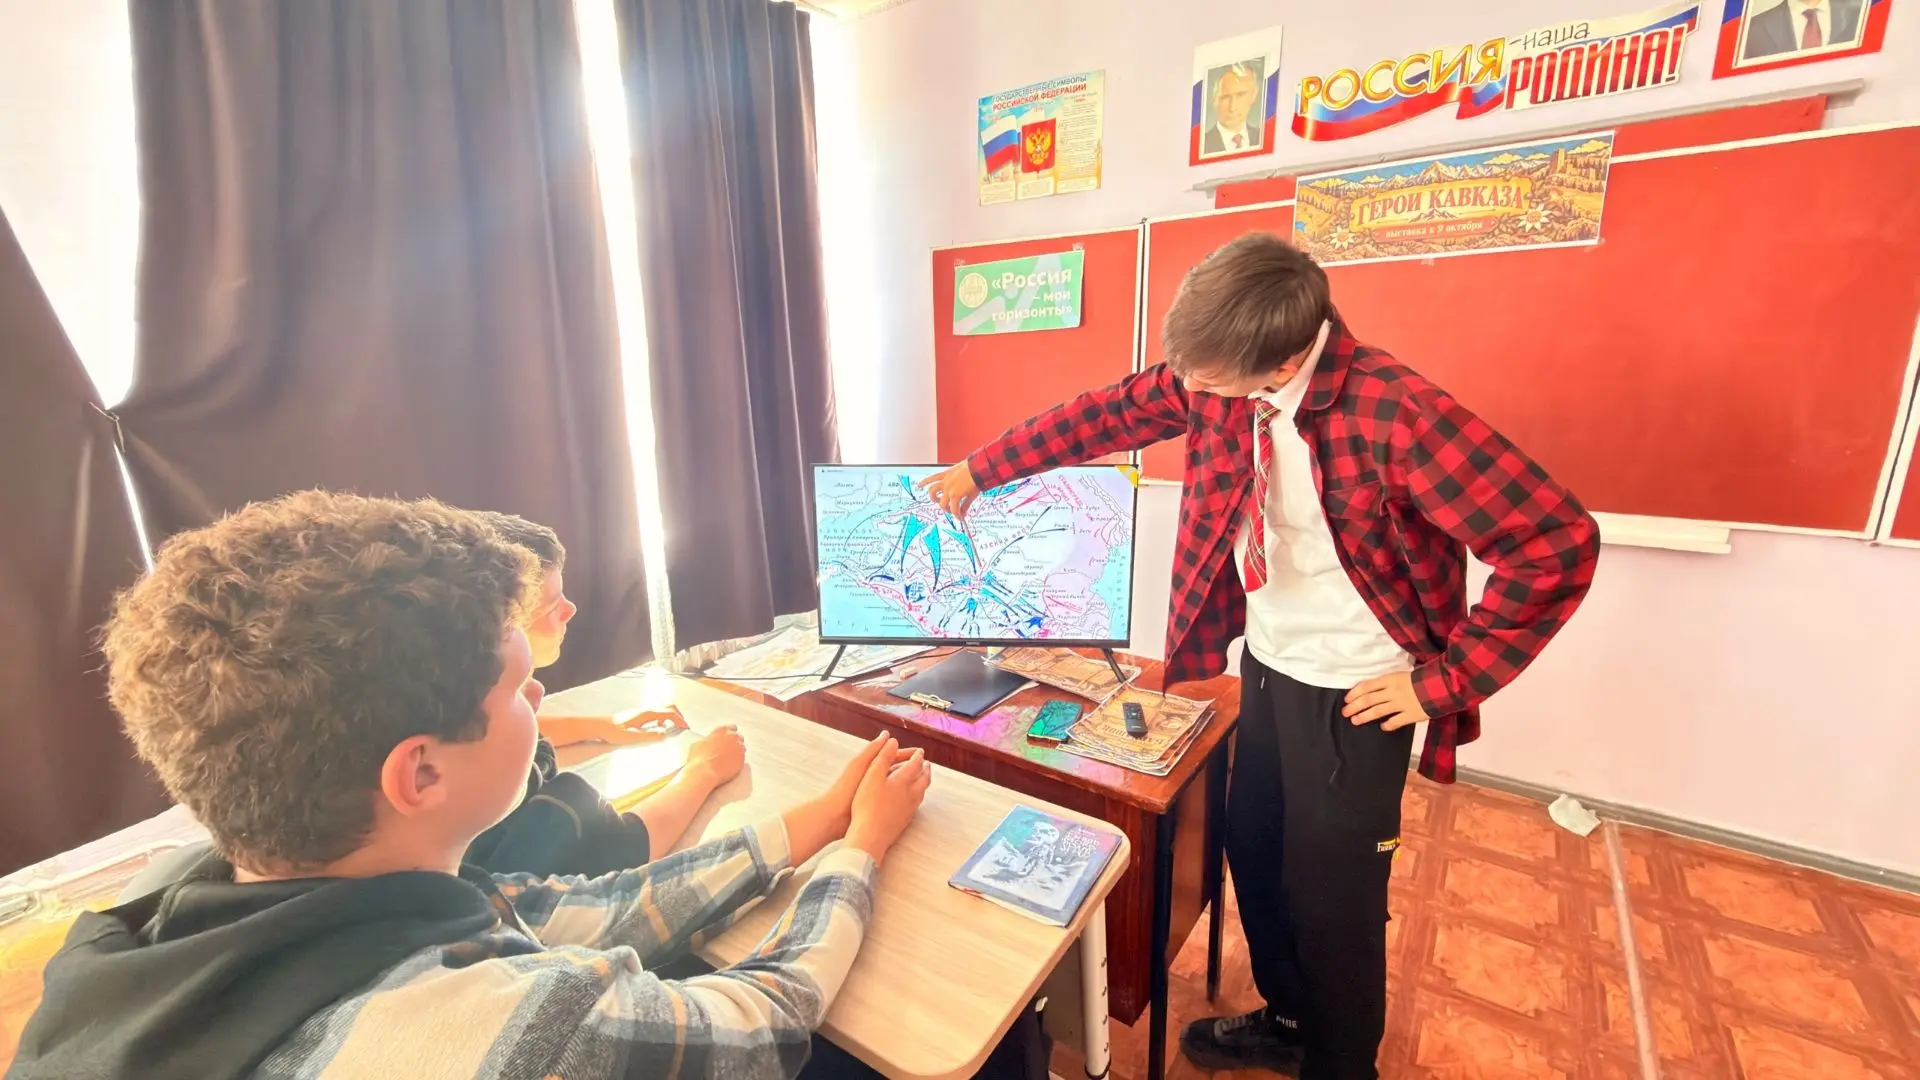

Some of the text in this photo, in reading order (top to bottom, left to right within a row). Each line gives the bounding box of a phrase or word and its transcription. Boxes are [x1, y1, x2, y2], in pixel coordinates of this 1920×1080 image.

[1300, 37, 1507, 114] РОССИЯ
[1505, 26, 1686, 110] РОДИНА!
[1052, 75, 1087, 90] СИМВОЛЫ
[992, 83, 1087, 112] РОССИЙСКОЙ ФЕДЕРАЦИИ
[1357, 185, 1523, 225] ГЕРОИ КАВКАЗА
[1386, 228, 1427, 239] выставка
[1436, 225, 1444, 233] 9
[1445, 221, 1483, 233] октября
[991, 268, 1073, 290] «Россия
[1043, 289, 1071, 303] мои
[991, 305, 1073, 325] горизонты»
